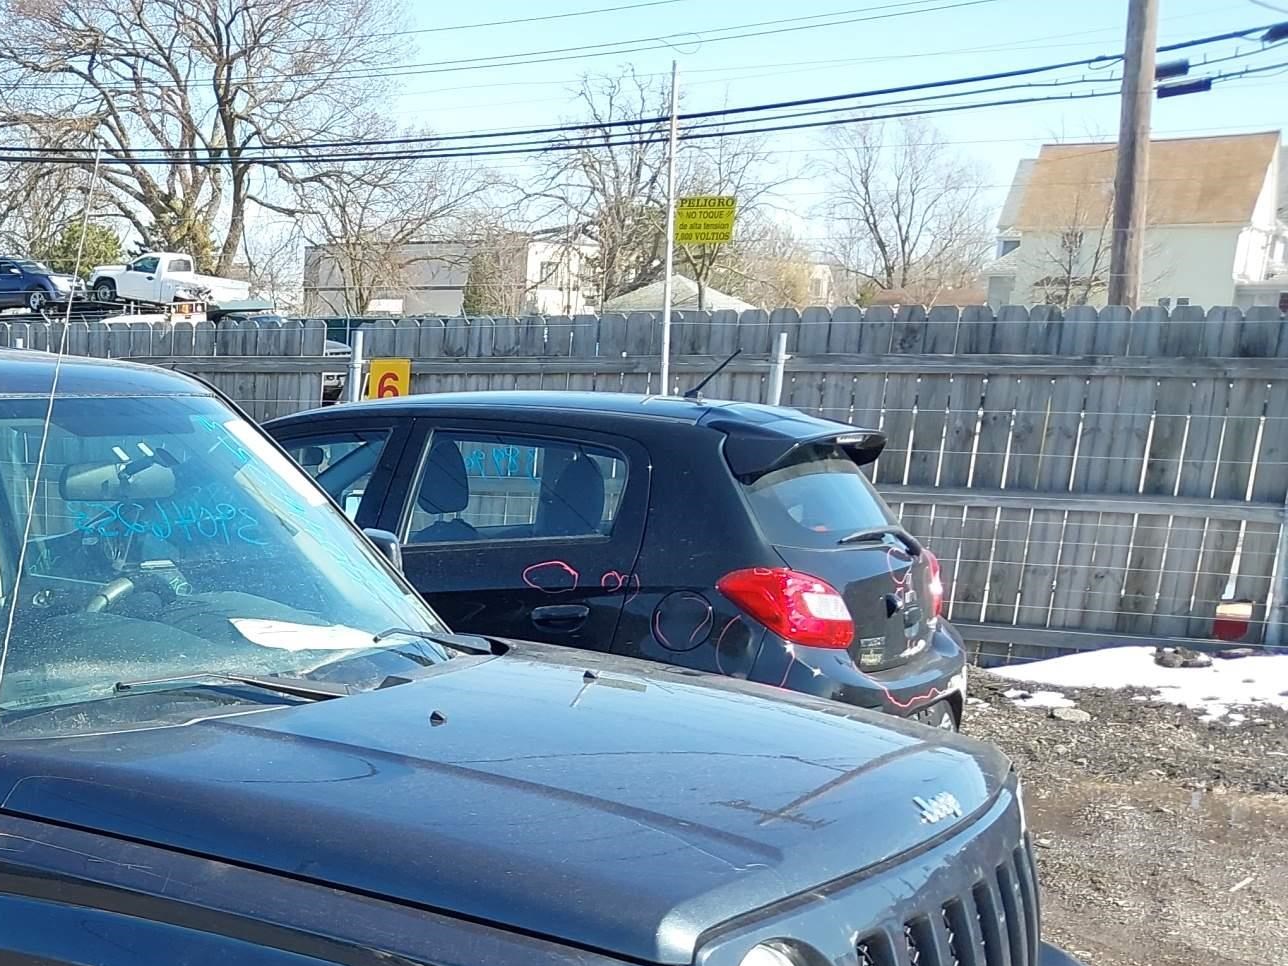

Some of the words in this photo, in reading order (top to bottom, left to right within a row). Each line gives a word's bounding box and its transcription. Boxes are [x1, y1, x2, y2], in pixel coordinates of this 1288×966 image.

[679, 198, 735, 208] PELIGRO
[686, 211, 697, 219] NO
[699, 211, 725, 219] TOQUE
[695, 231, 730, 241] VOLTIOS
[377, 372, 400, 399] 6
